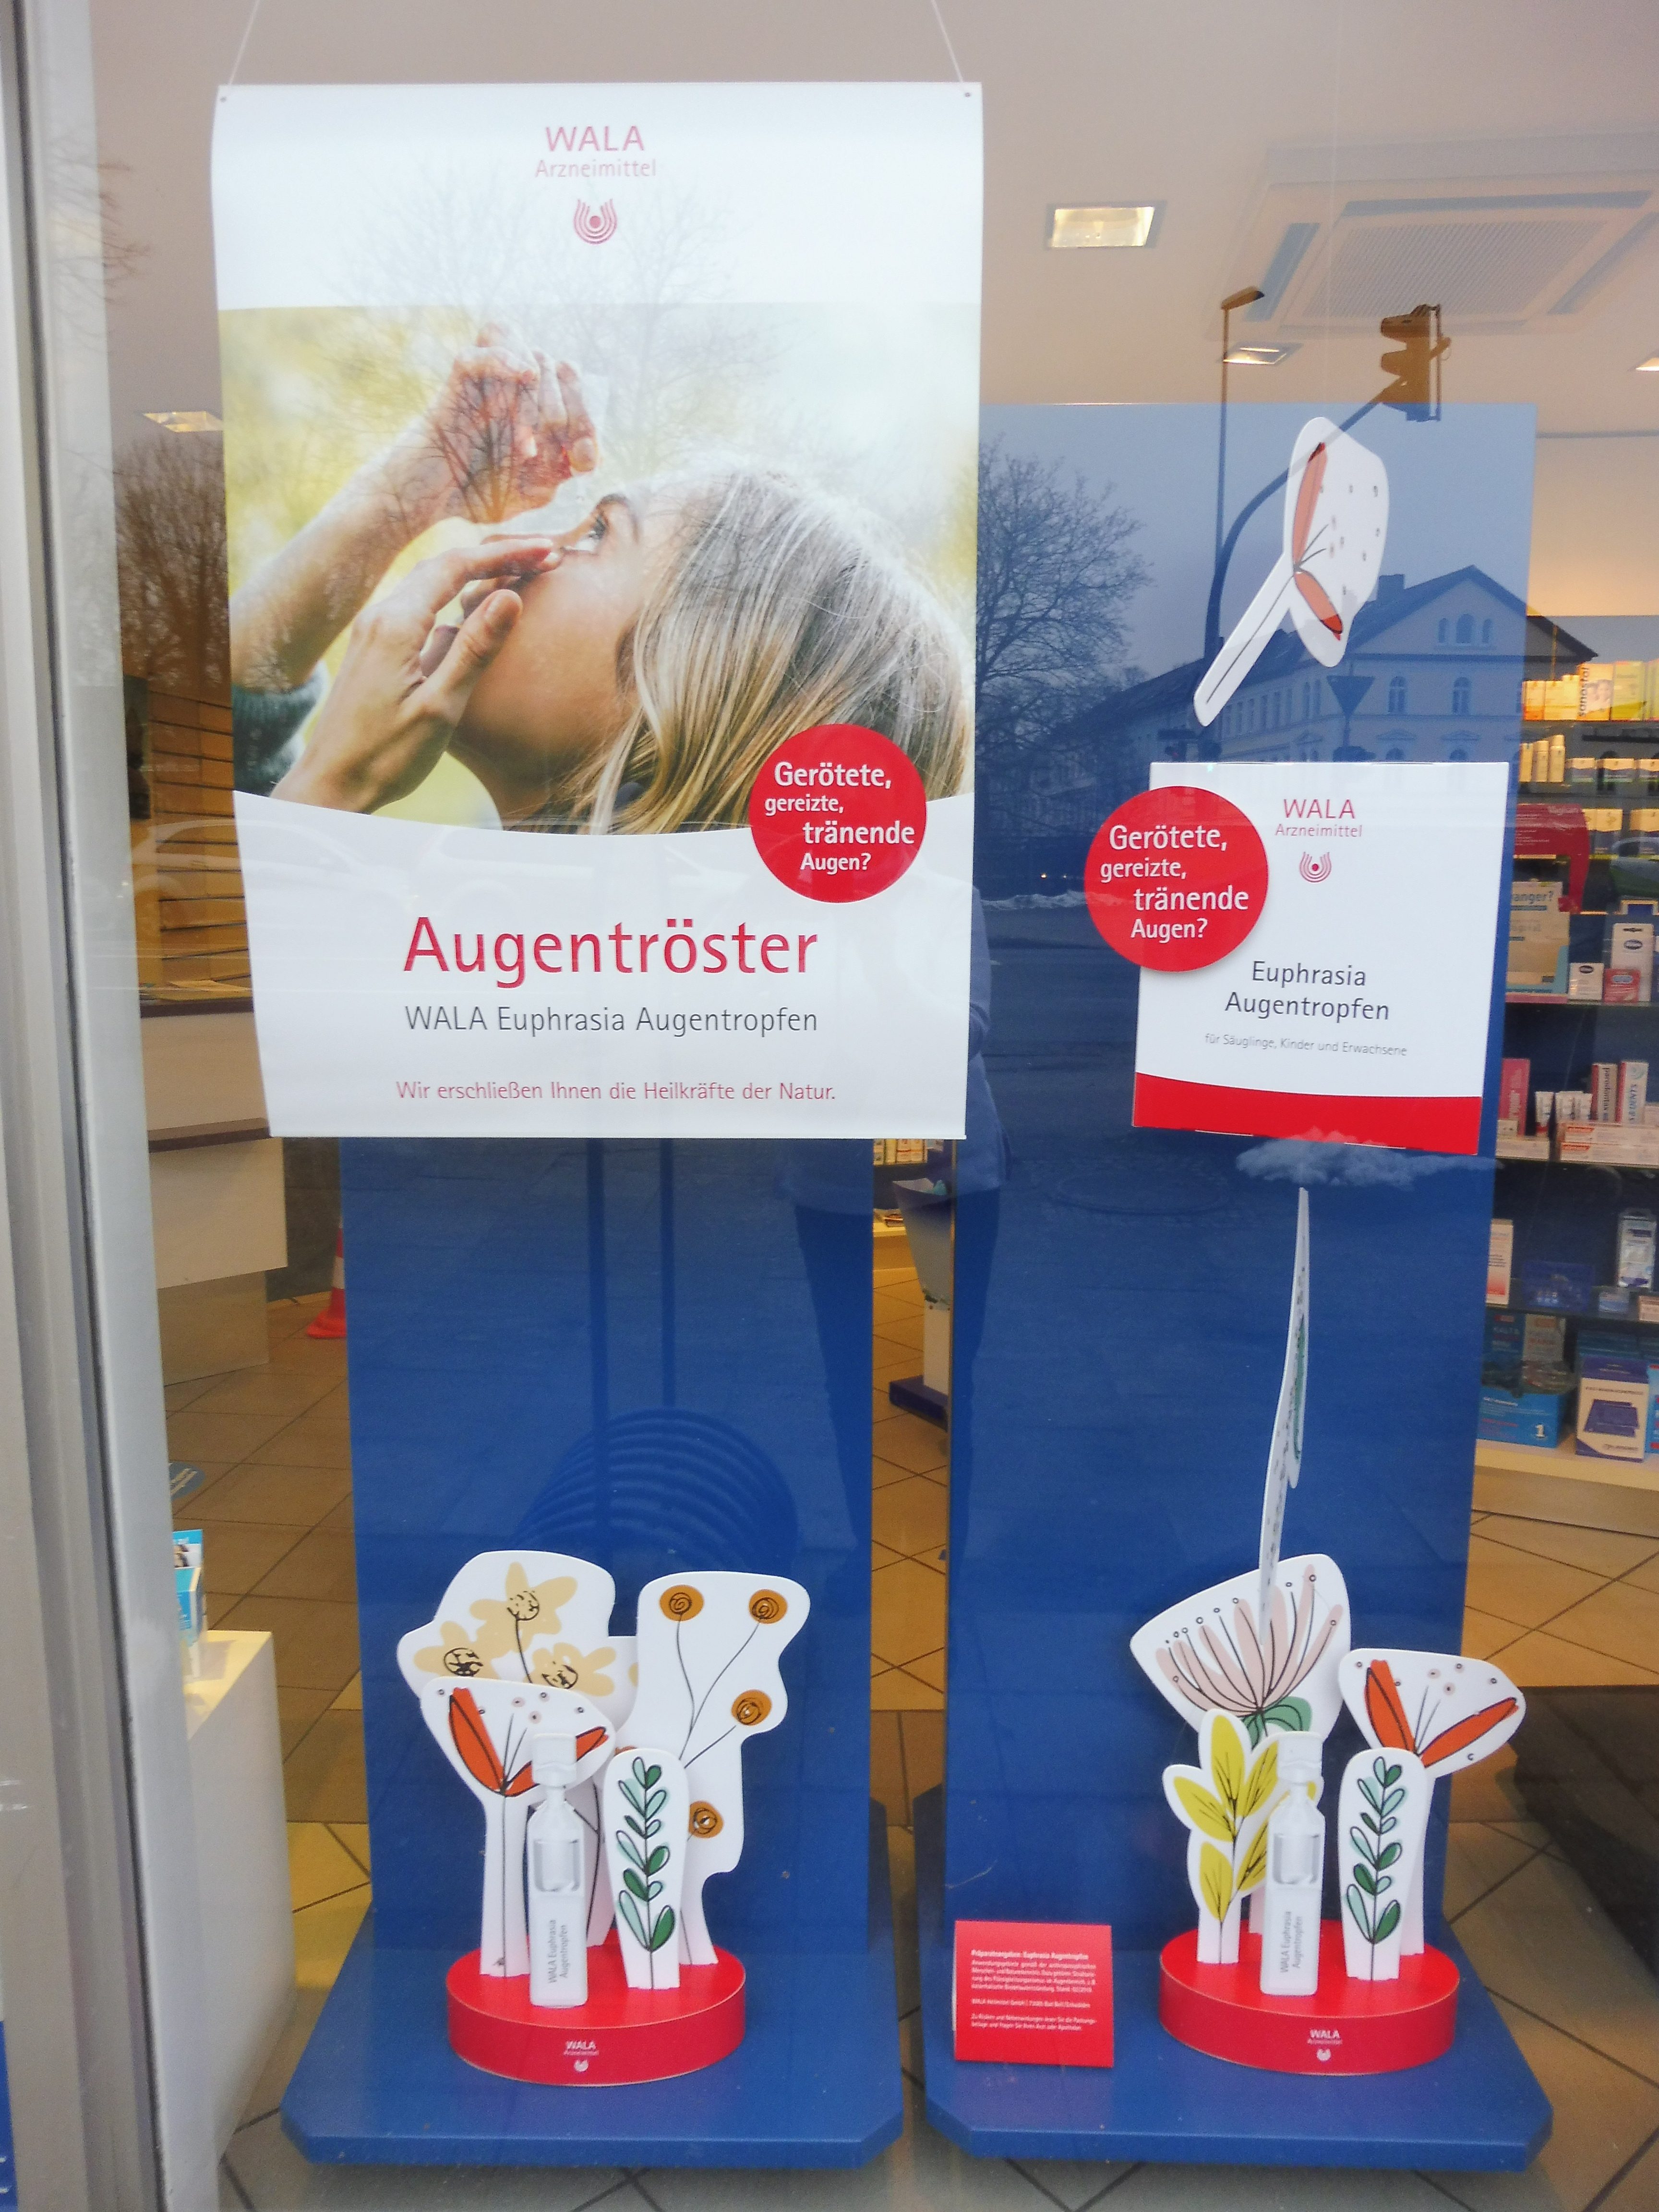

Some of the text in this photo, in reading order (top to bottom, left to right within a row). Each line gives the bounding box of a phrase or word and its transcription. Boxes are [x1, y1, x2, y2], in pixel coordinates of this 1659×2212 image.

[546, 125, 644, 151] WALA
[535, 159, 656, 177] Arzneimittel
[774, 761, 891, 789] Gerötete,
[765, 793, 844, 816] gereizte,
[1284, 799, 1355, 819] WALA
[803, 820, 915, 843] tränende
[1109, 825, 1227, 851] Gerötete,
[1275, 824, 1362, 837] Arzneimittel
[800, 853, 871, 875] Augen?
[1100, 857, 1187, 883] gereizte,
[1133, 885, 1249, 911] tränende
[1130, 918, 1208, 943] Augen?
[403, 916, 818, 988] Augentröster
[1253, 961, 1366, 988] Euphrasia
[1225, 991, 1389, 1023] Augentropfen
[405, 1006, 817, 1037] WALA Euphrasia Augentropfen
[1205, 1033, 1407, 1056] für Säuglinge, Kinder und Erwachsene
[397, 1082, 835, 1100] Wir erschließen Ihnen die Heilkräfte der Natur.
